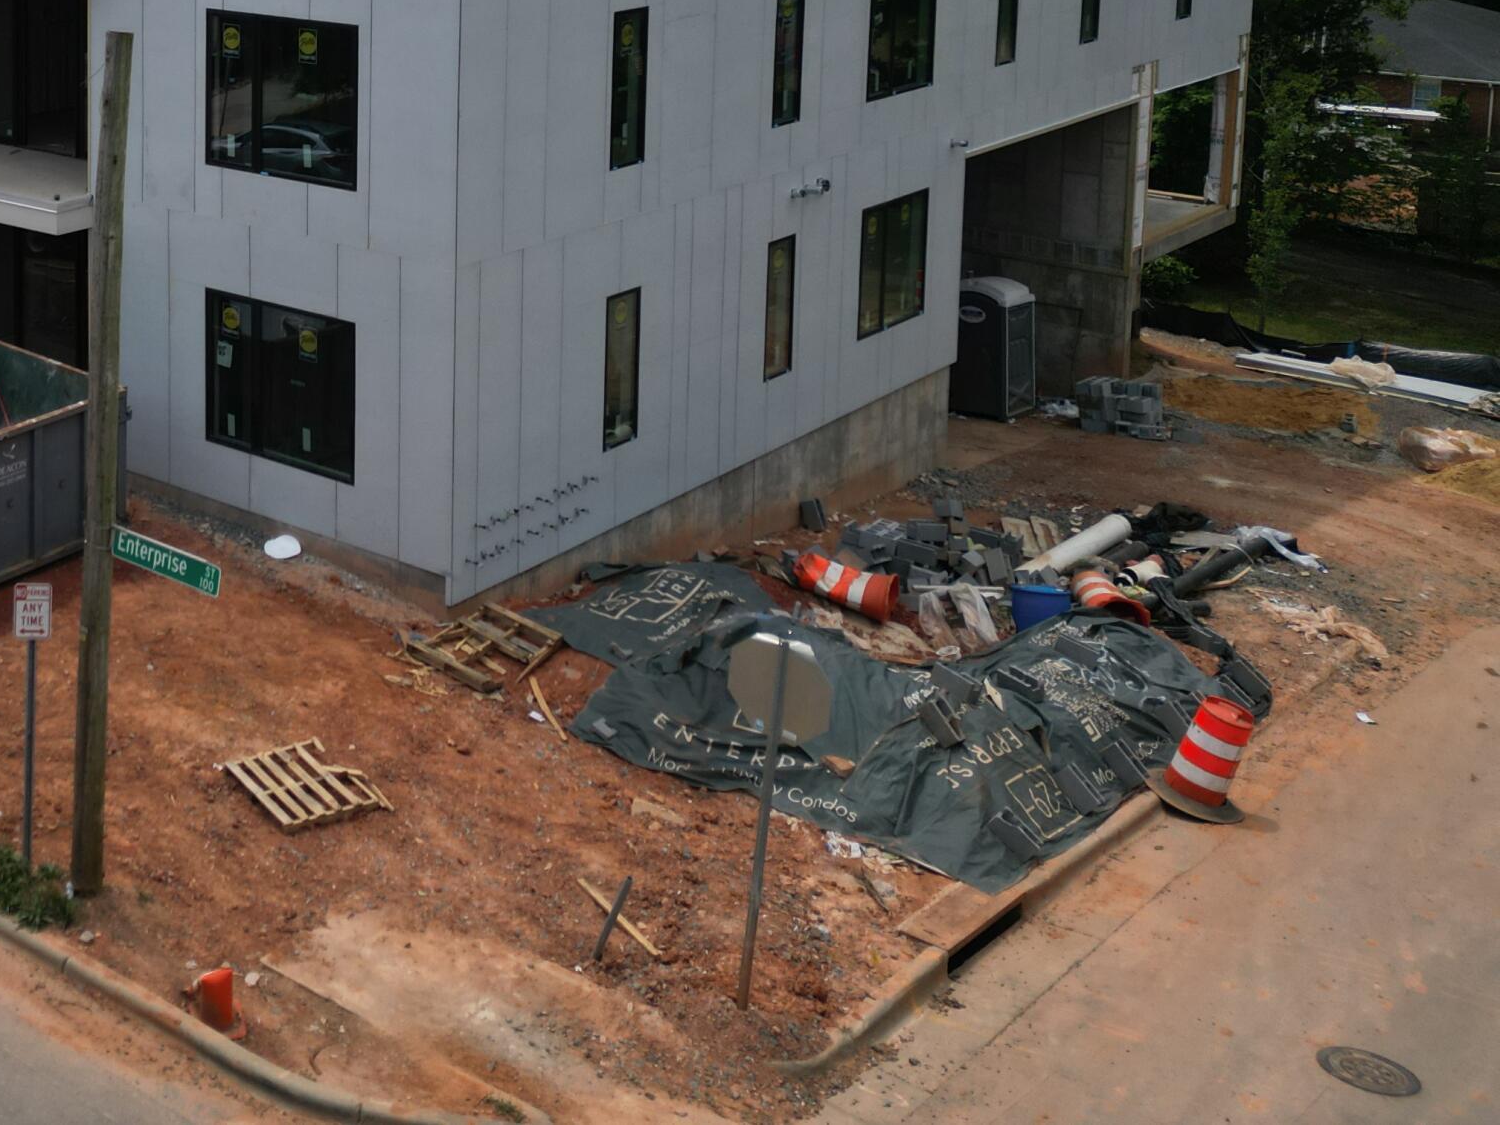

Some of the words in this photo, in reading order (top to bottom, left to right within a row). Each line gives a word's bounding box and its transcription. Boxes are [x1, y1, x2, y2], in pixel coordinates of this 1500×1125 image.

[117, 532, 187, 576] Enterprise
[204, 565, 216, 580] ST
[199, 577, 215, 592] 100
[22, 603, 43, 613] ANY
[20, 615, 44, 626] TIME
[788, 787, 858, 823] Condos
